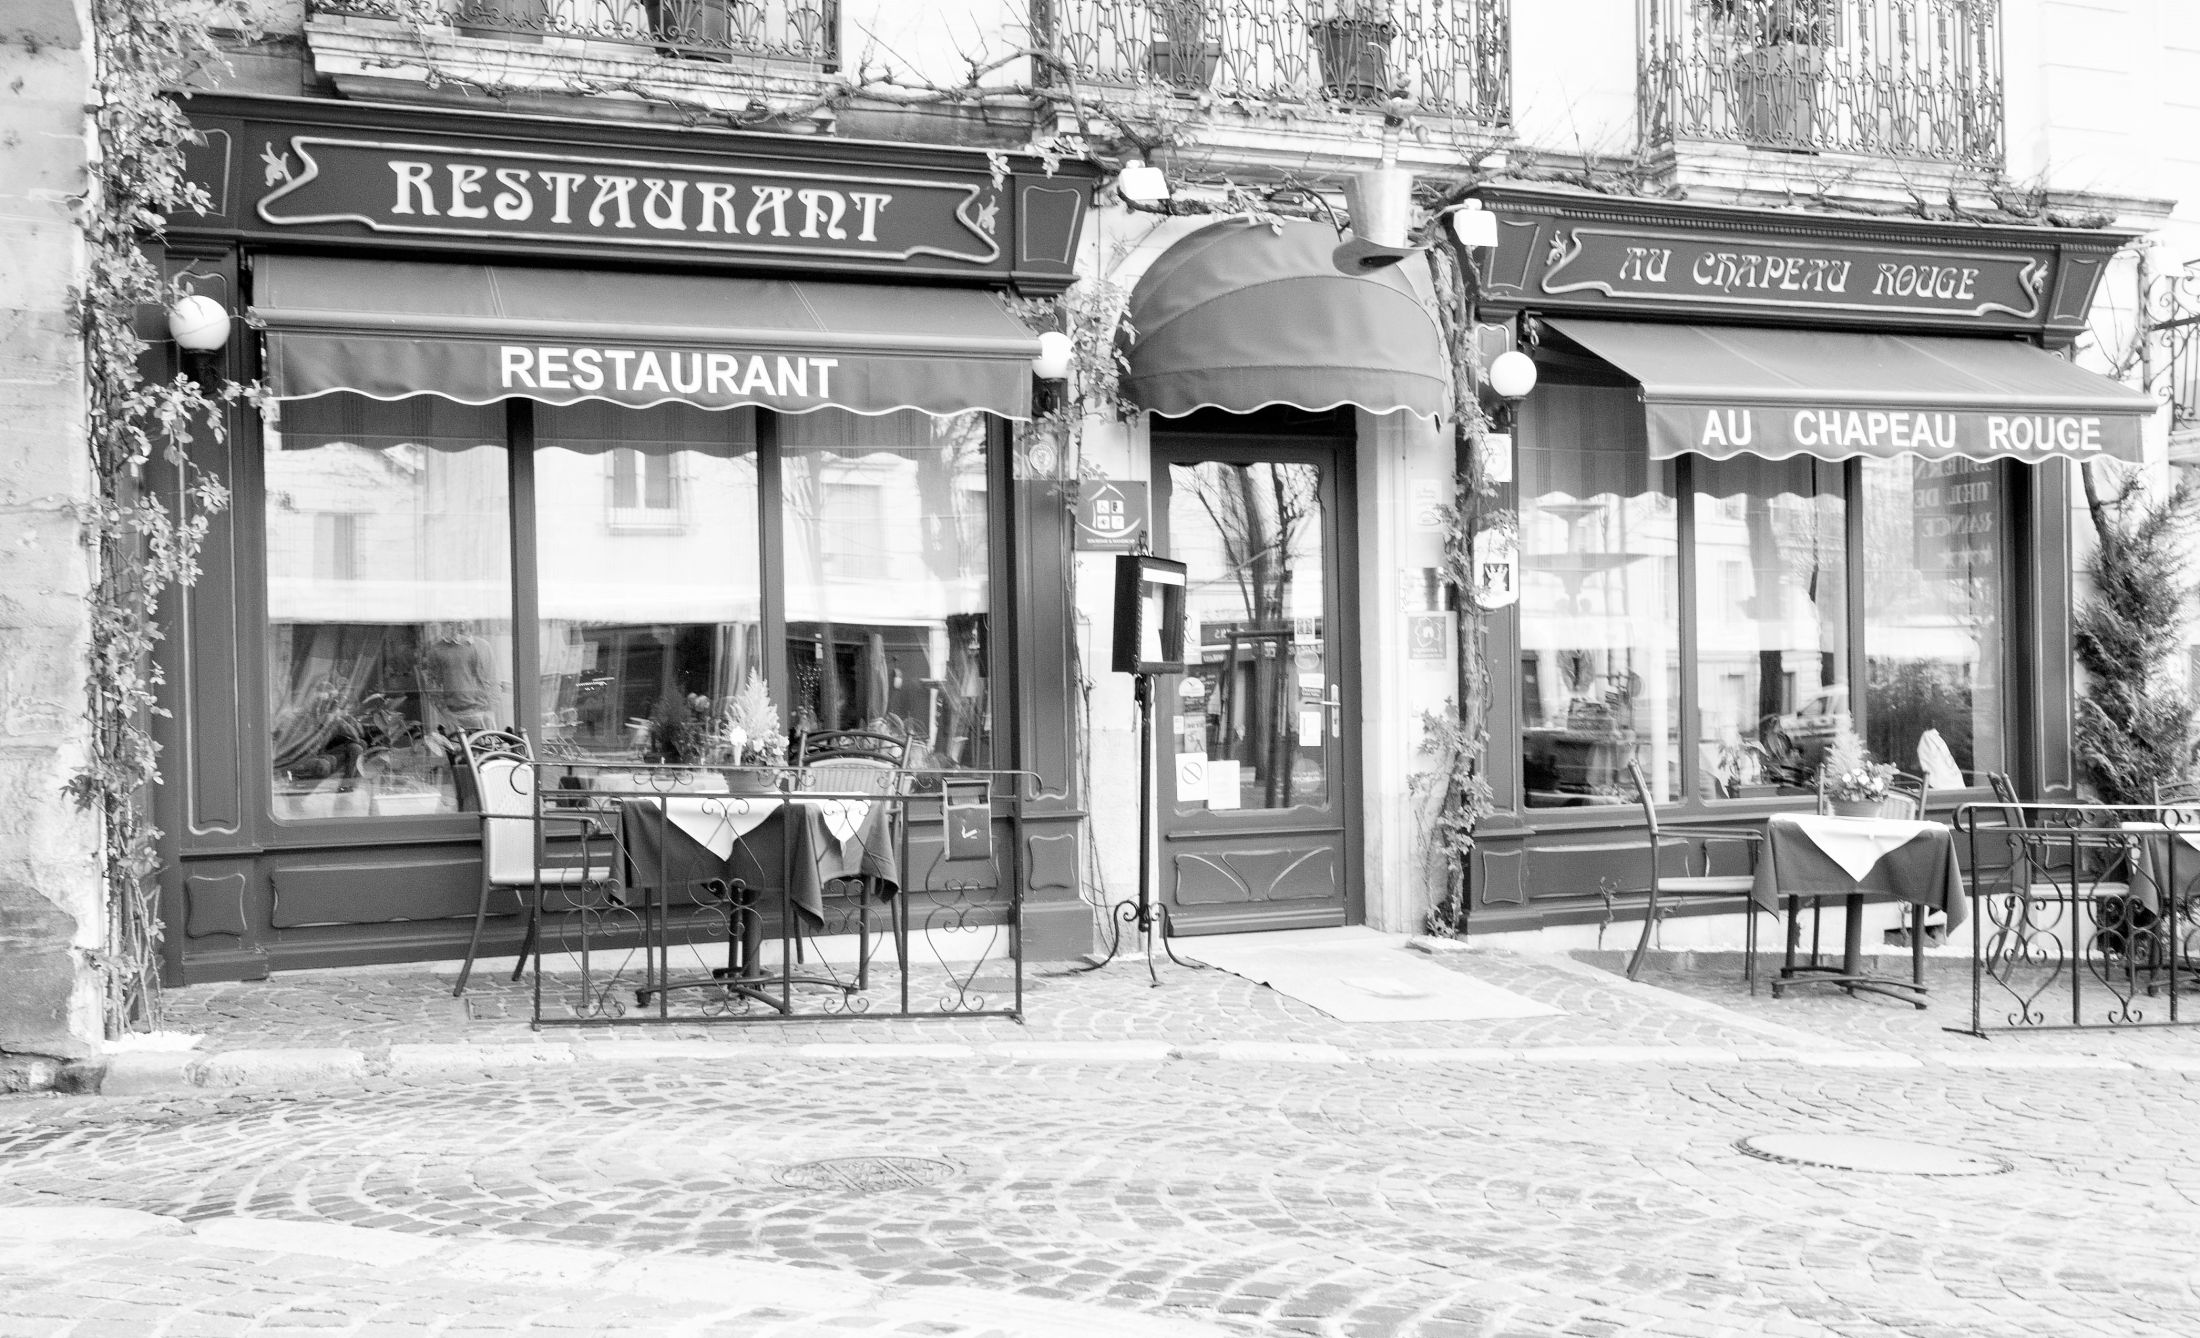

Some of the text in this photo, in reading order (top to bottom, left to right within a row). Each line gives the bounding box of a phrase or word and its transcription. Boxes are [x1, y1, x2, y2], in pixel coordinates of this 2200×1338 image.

[387, 160, 893, 243] RESTAURANT
[1618, 246, 1980, 301] AU CHAPEAU ROUGE
[500, 345, 839, 399] RESTAURANT
[1701, 409, 2103, 451] AU CHAPEAU ROUGE
